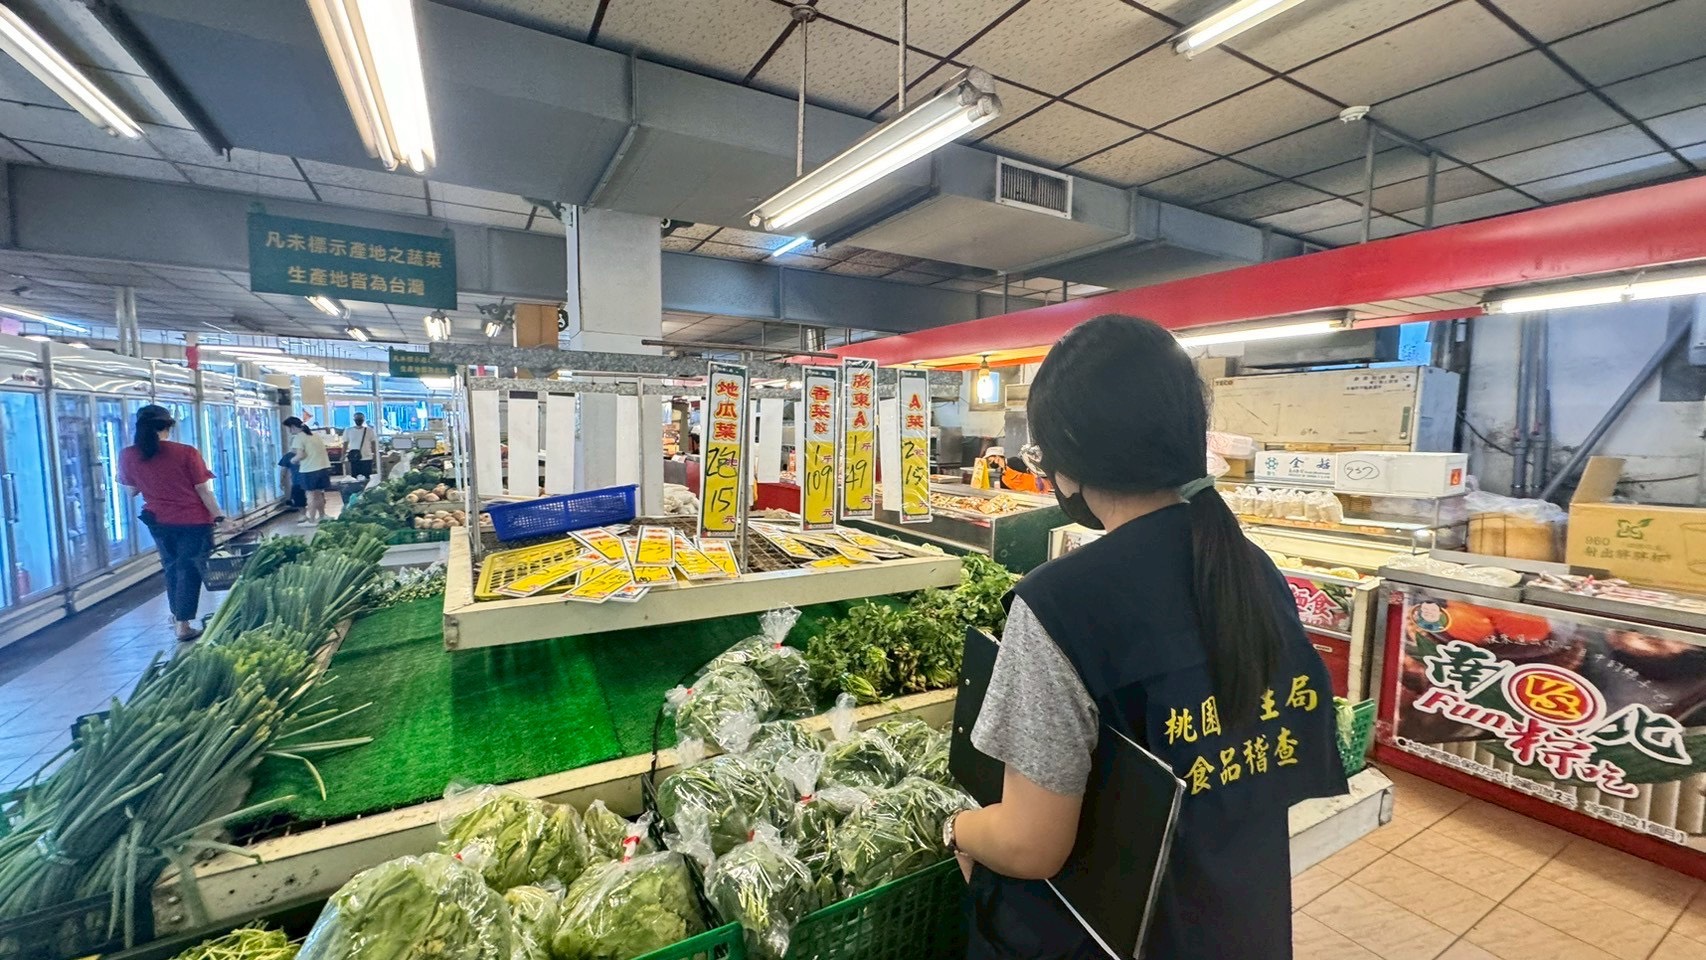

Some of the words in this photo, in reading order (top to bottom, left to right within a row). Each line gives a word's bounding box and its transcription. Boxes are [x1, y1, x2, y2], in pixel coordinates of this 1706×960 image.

[265, 231, 442, 268] 凡未標示產地之蔬菜
[287, 265, 425, 296] 生產地皆為台灣
[714, 381, 740, 441] 地瓜葉
[907, 394, 924, 429] A菜
[710, 487, 734, 513] 15
[806, 465, 833, 502] 109
[723, 516, 736, 524] 元
[1430, 642, 1500, 693] 南
[1163, 674, 1319, 746] 桃園生局
[1421, 691, 1507, 731] Fun
[1183, 726, 1299, 796] 食品稽查
